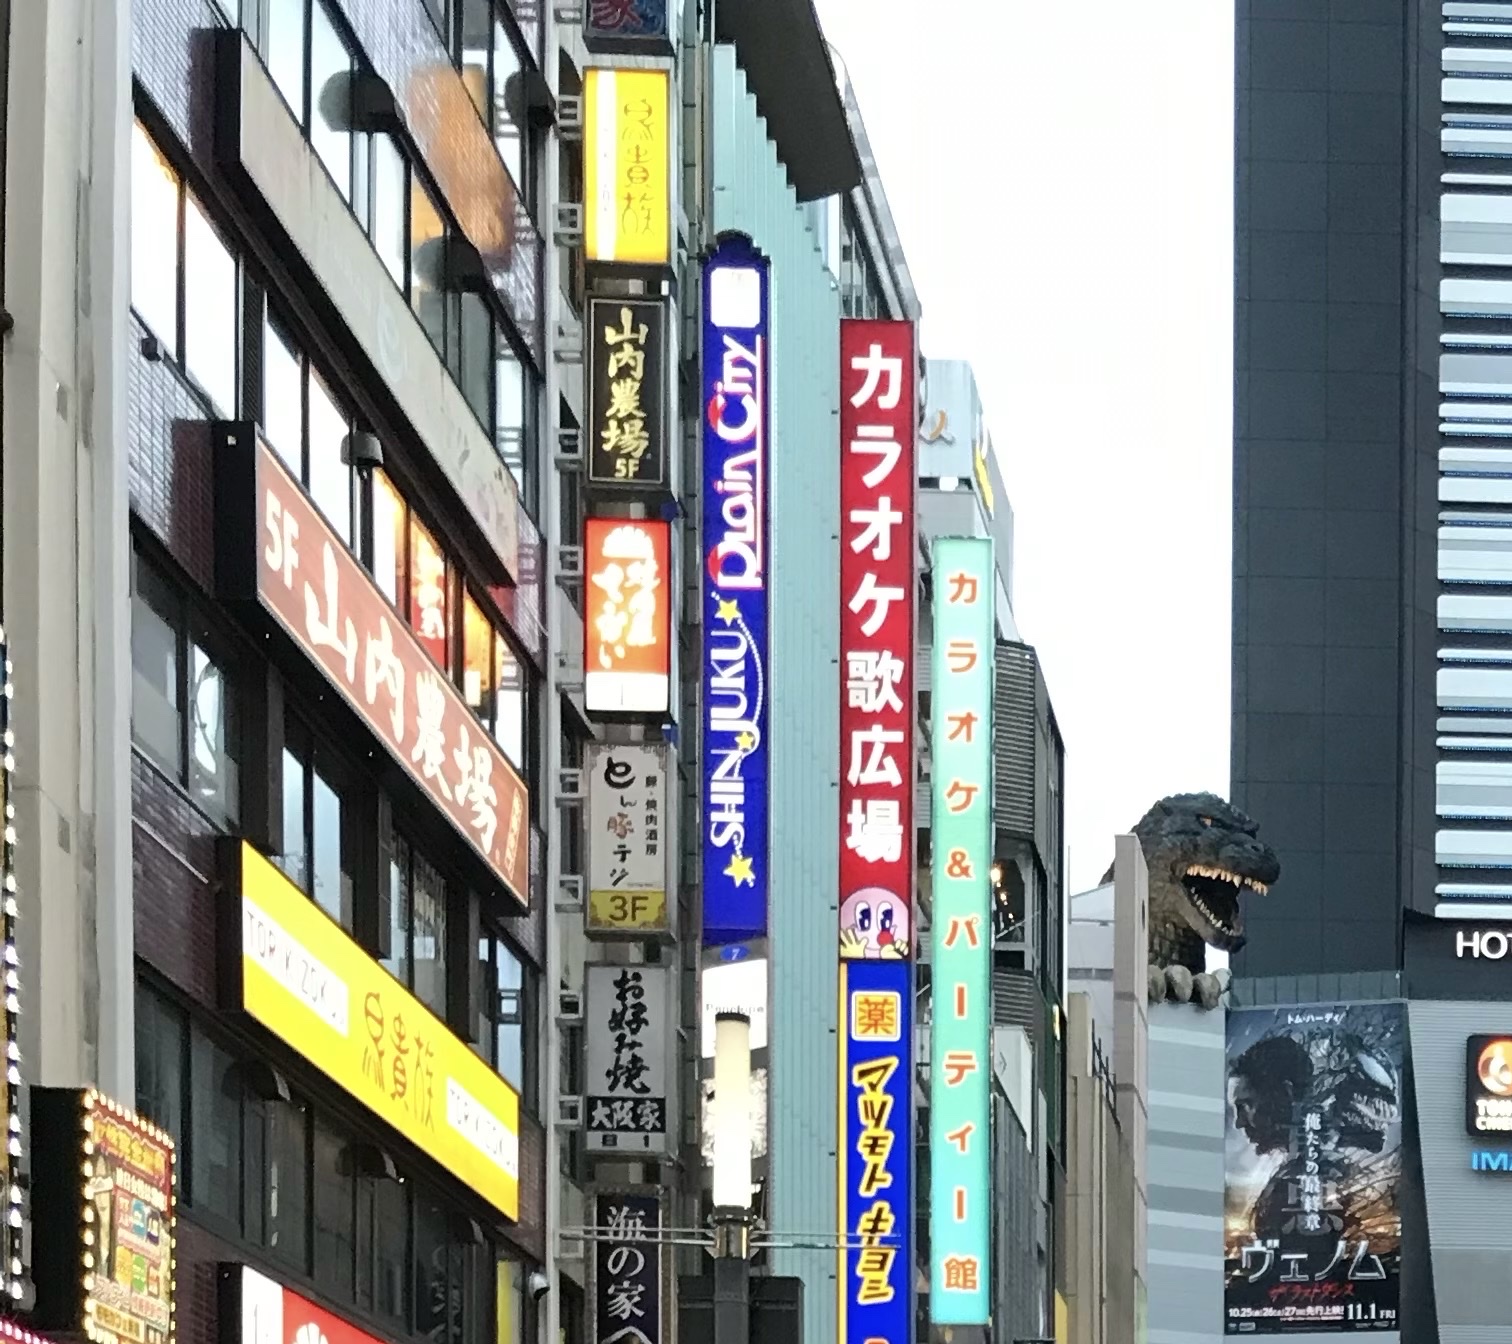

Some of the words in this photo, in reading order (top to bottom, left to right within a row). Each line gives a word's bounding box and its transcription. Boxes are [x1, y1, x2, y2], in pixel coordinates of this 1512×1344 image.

[601, 306, 649, 458] 山内農場
[614, 458, 640, 479] 5F
[848, 344, 904, 862] カラオケ歌広場
[264, 490, 298, 589] 5F
[305, 542, 498, 854] 山内農場
[710, 630, 761, 847] SHINJUKU
[608, 896, 649, 921] 3F
[608, 970, 649, 1095] お好み焼
[858, 998, 897, 1036] 薬
[592, 1100, 662, 1131] 大阪家
[852, 1056, 900, 1305] マツモトキヨシ
[607, 1206, 646, 1320] 海の家
[1241, 1239, 1387, 1283] ヴェノム
[1347, 1302, 1376, 1320] 11.1
[1380, 1310, 1396, 1319] FRI
